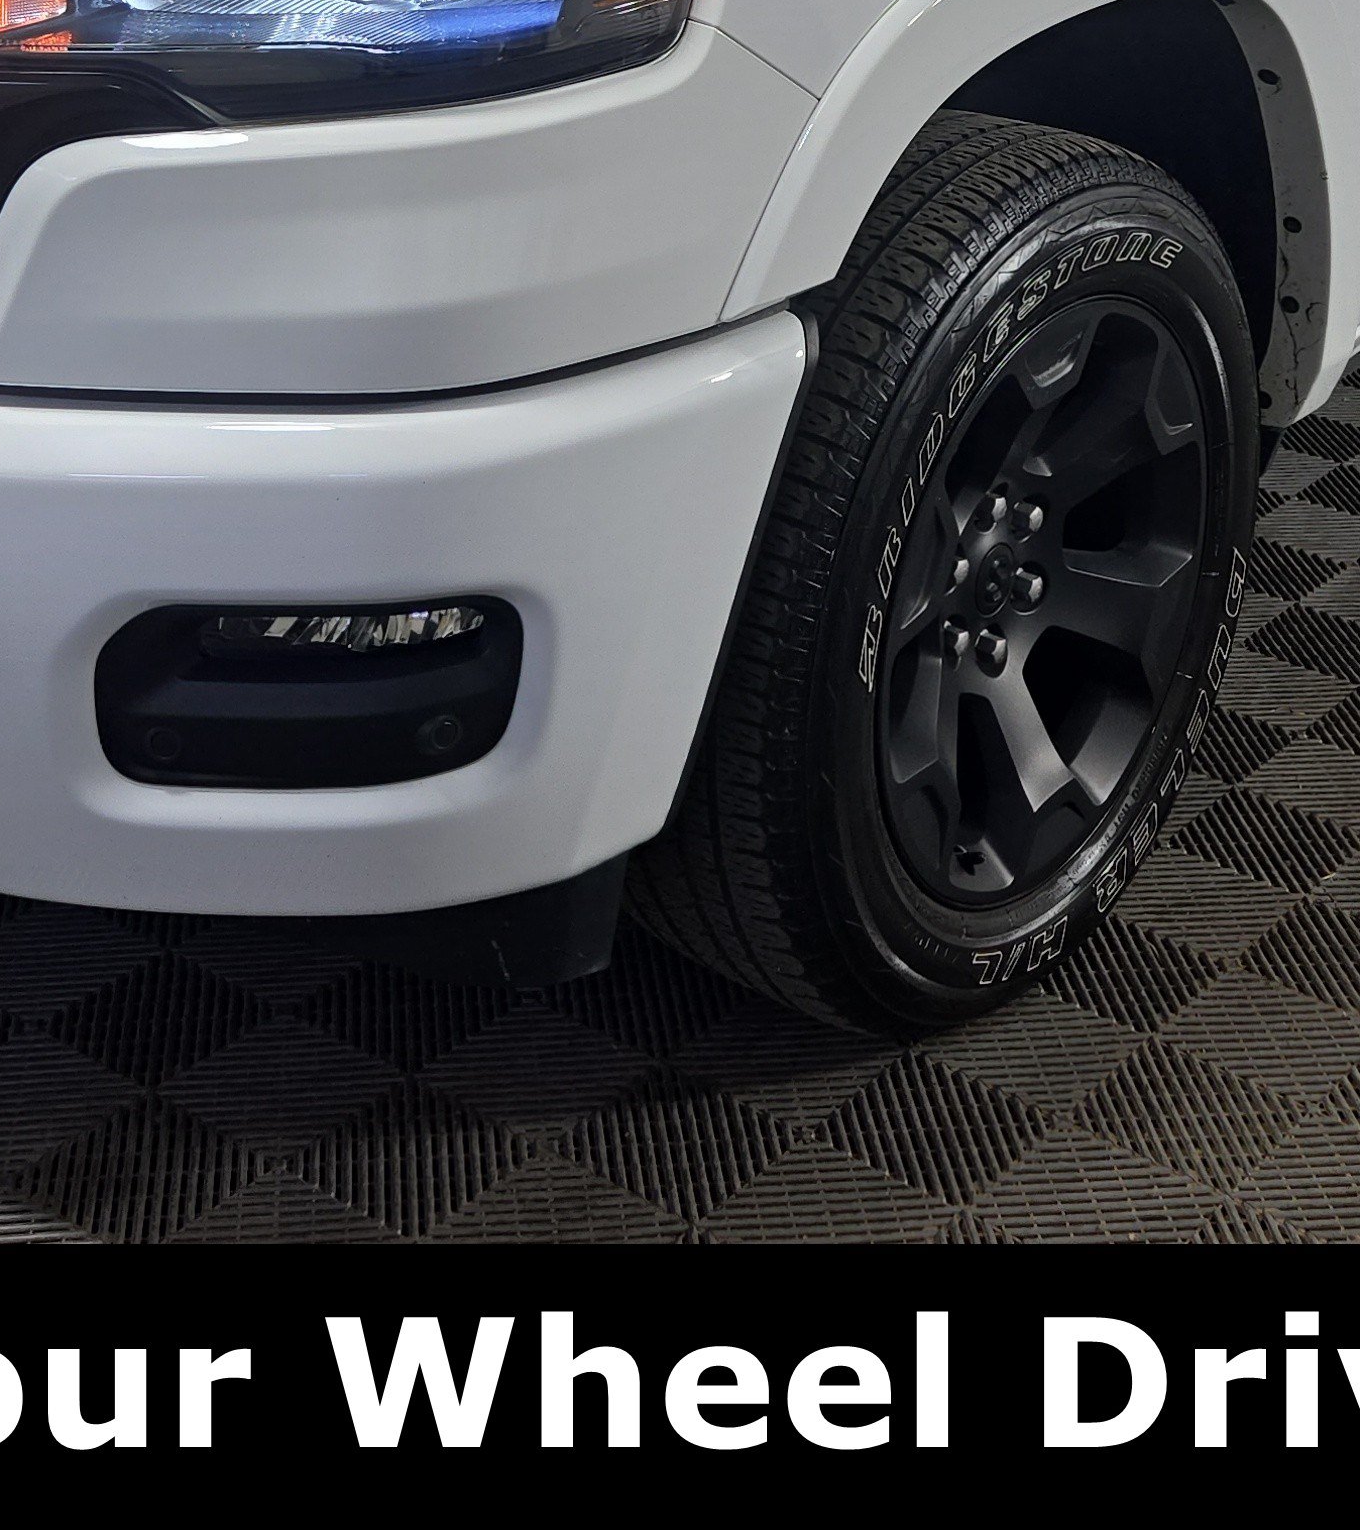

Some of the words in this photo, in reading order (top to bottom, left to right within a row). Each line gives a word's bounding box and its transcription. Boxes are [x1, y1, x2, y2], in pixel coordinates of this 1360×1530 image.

[857, 230, 1184, 693] BRIDGESTONE
[1093, 545, 1248, 914] DUELER
[971, 914, 1070, 986] H/L
